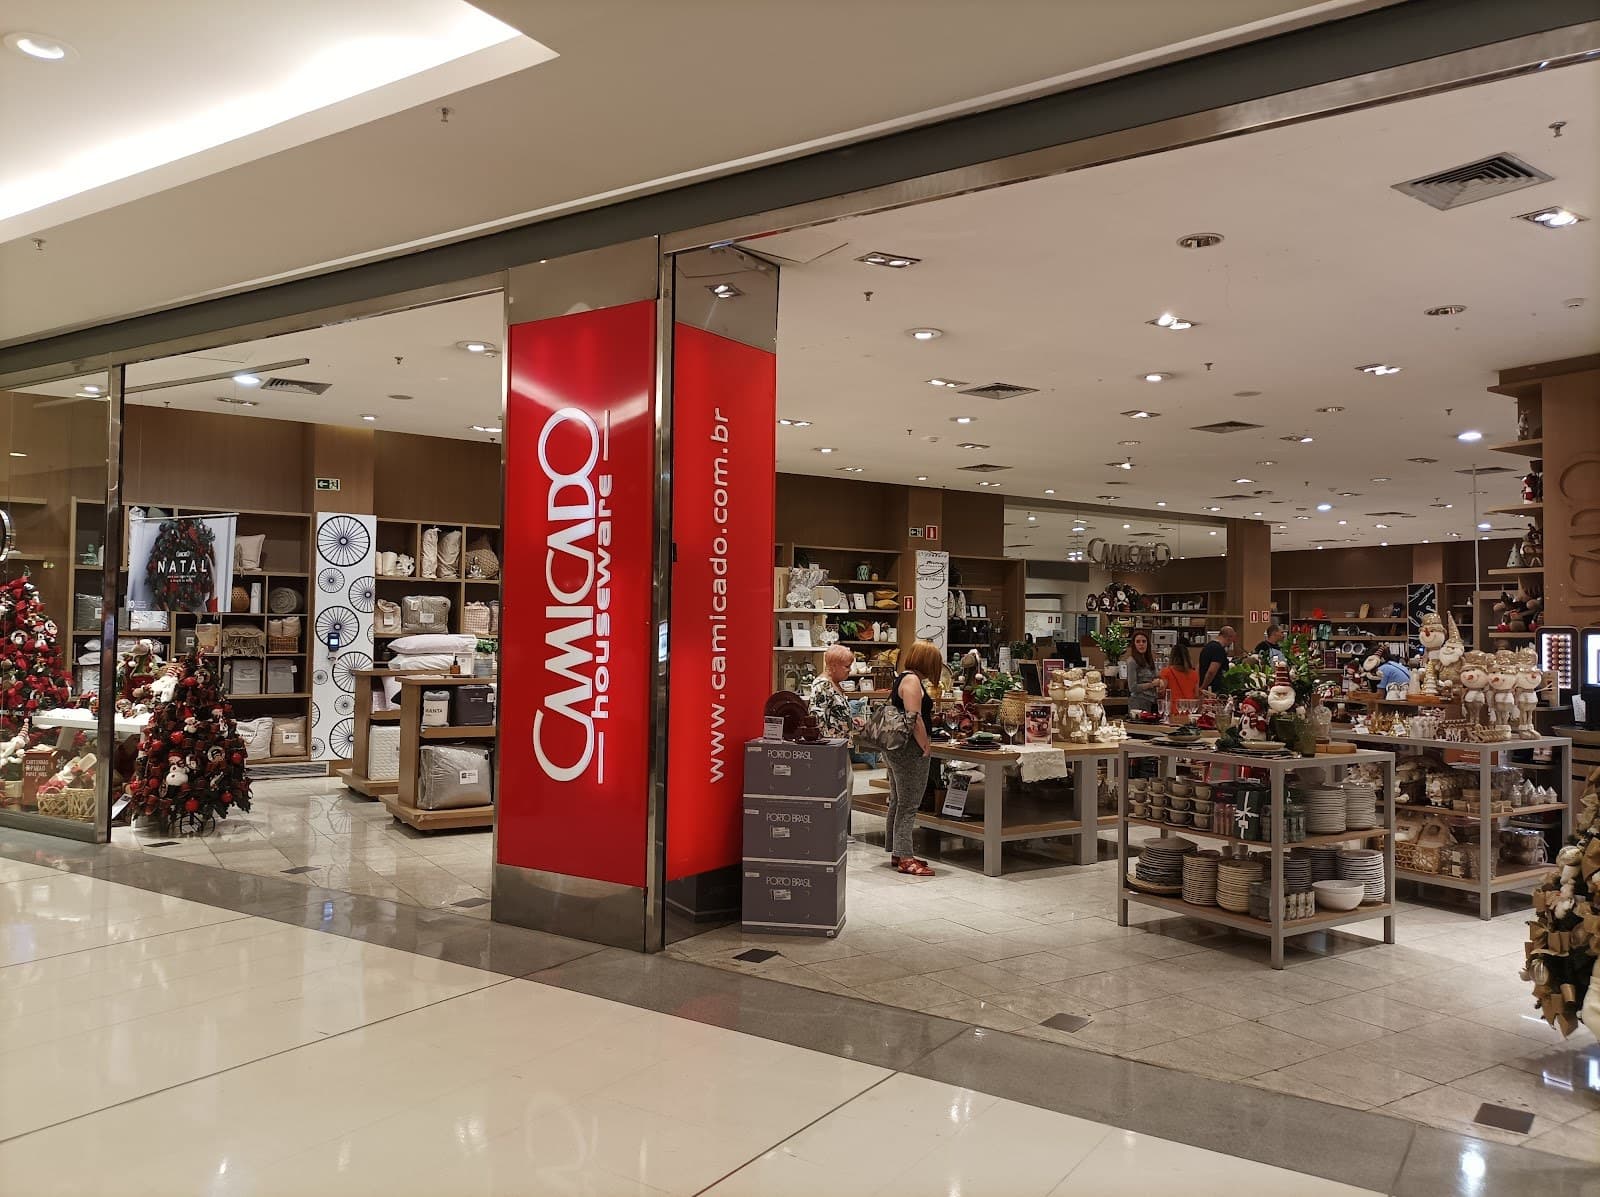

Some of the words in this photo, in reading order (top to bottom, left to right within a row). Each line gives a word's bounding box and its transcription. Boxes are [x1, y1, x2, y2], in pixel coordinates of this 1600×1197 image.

[157, 560, 208, 573] NATAL
[533, 407, 599, 781] CAMICADO
[591, 474, 612, 719] houseware
[710, 407, 729, 784] www.camicado.com.br
[767, 749, 792, 760] PORTO
[792, 750, 812, 760] BRASIL
[766, 813, 791, 822] PORTO
[791, 814, 812, 823] BRASIL
[766, 877, 791, 886] PORTO
[791, 878, 812, 887] BRASIL
